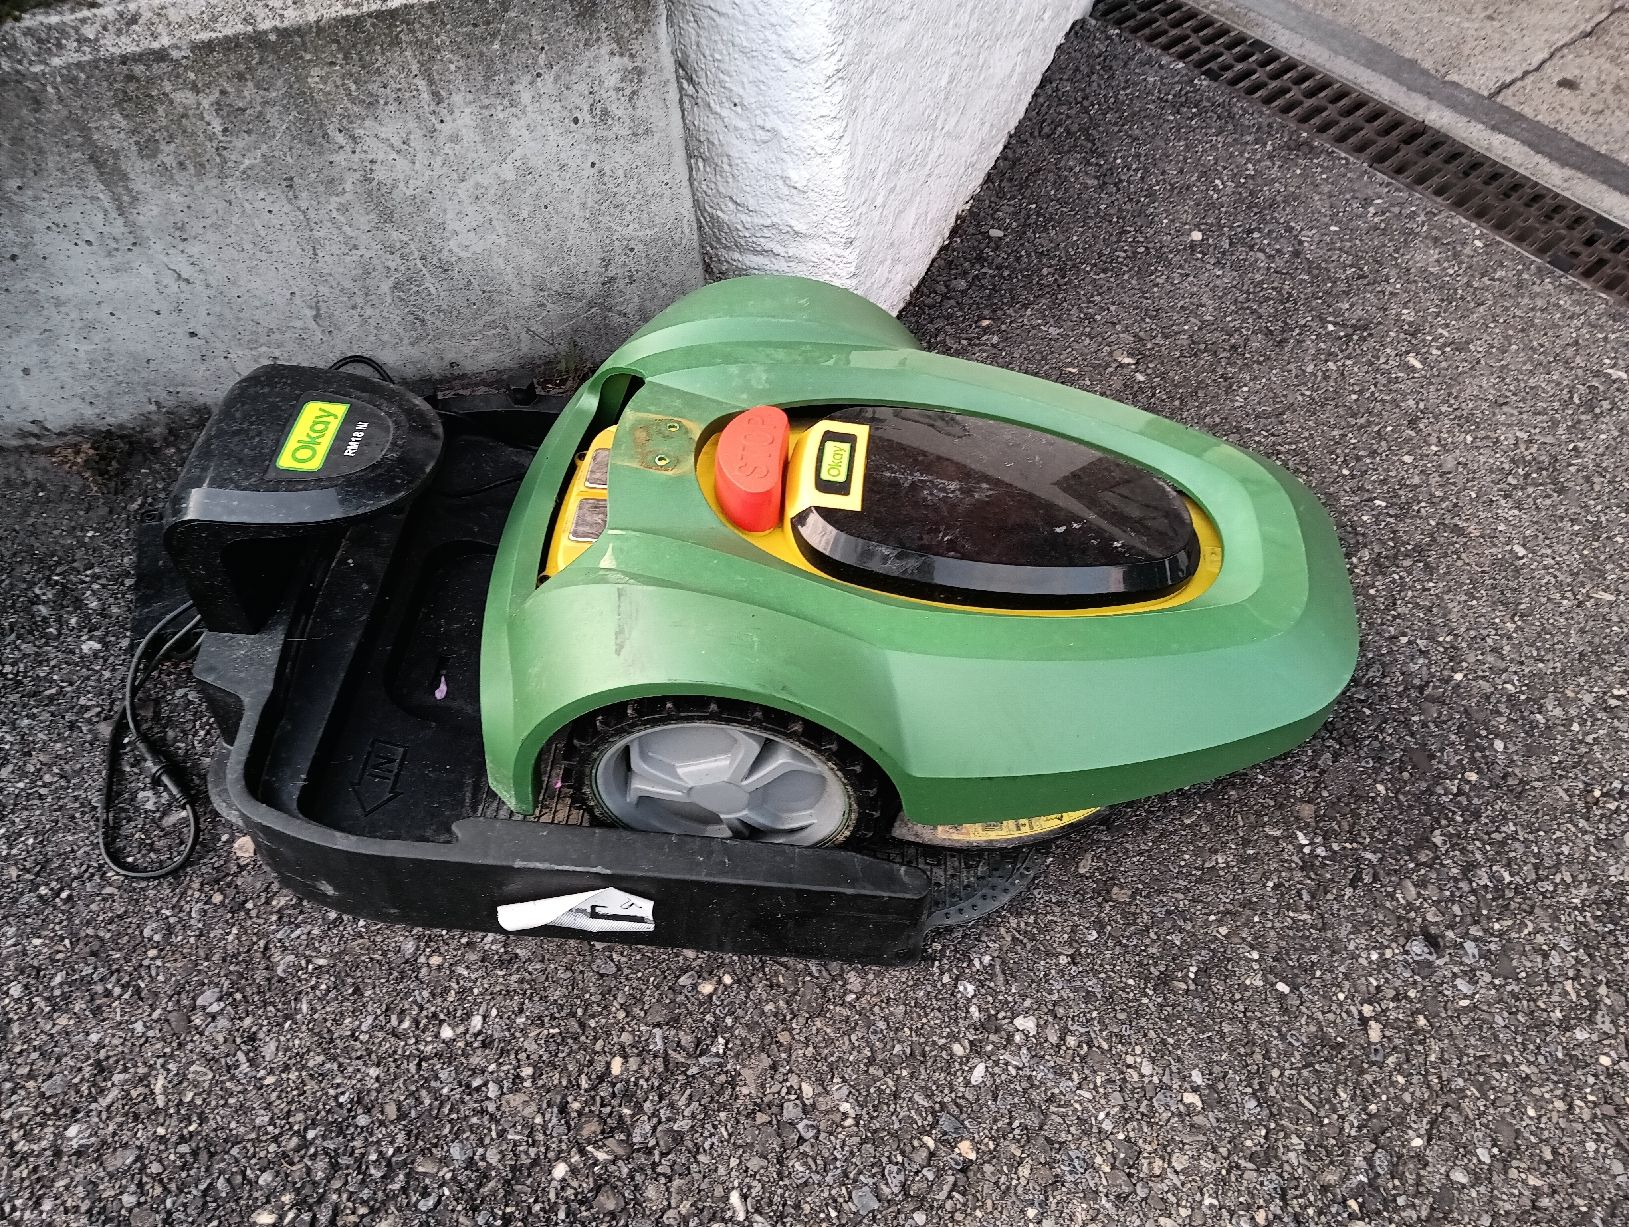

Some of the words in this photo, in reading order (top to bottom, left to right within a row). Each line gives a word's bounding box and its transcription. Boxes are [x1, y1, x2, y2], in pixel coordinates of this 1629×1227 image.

[291, 407, 339, 463] Okay
[344, 431, 365, 457] RM18
[738, 415, 775, 479] STOP
[827, 445, 846, 477] Okay
[366, 754, 400, 781] IN
